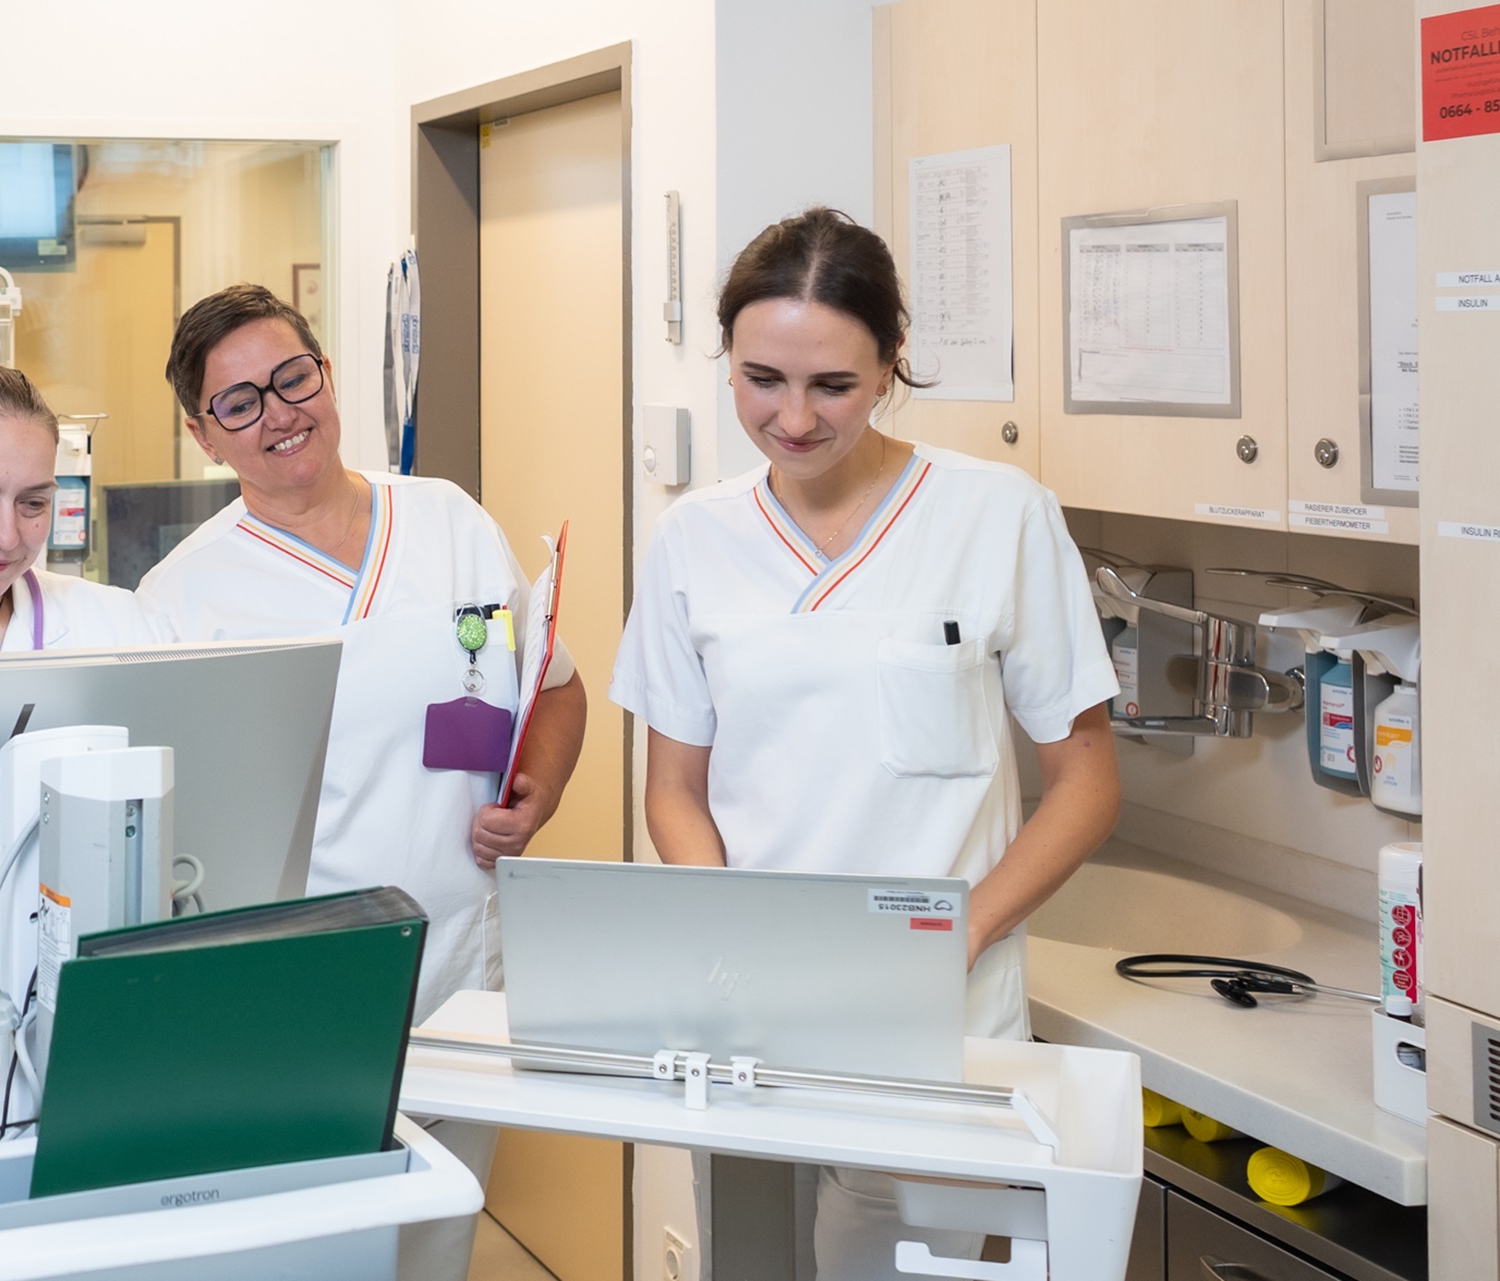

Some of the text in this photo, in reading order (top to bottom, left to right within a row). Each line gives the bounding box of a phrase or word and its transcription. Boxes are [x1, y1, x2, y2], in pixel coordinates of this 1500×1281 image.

[1439, 103, 1473, 119] 0664
[1458, 274, 1493, 283] NOTFALL
[1458, 299, 1488, 308] INSULIN
[1209, 506, 1265, 518] BLUTZUCKERAPPARAT
[1304, 503, 1367, 515] RASIERER ZUBEHOER
[1305, 517, 1371, 530] FIEBERTHERMOMETER
[1461, 526, 1500, 538] INSULIN R
[878, 903, 931, 912] HNB23015
[161, 1188, 220, 1207] ergotron
